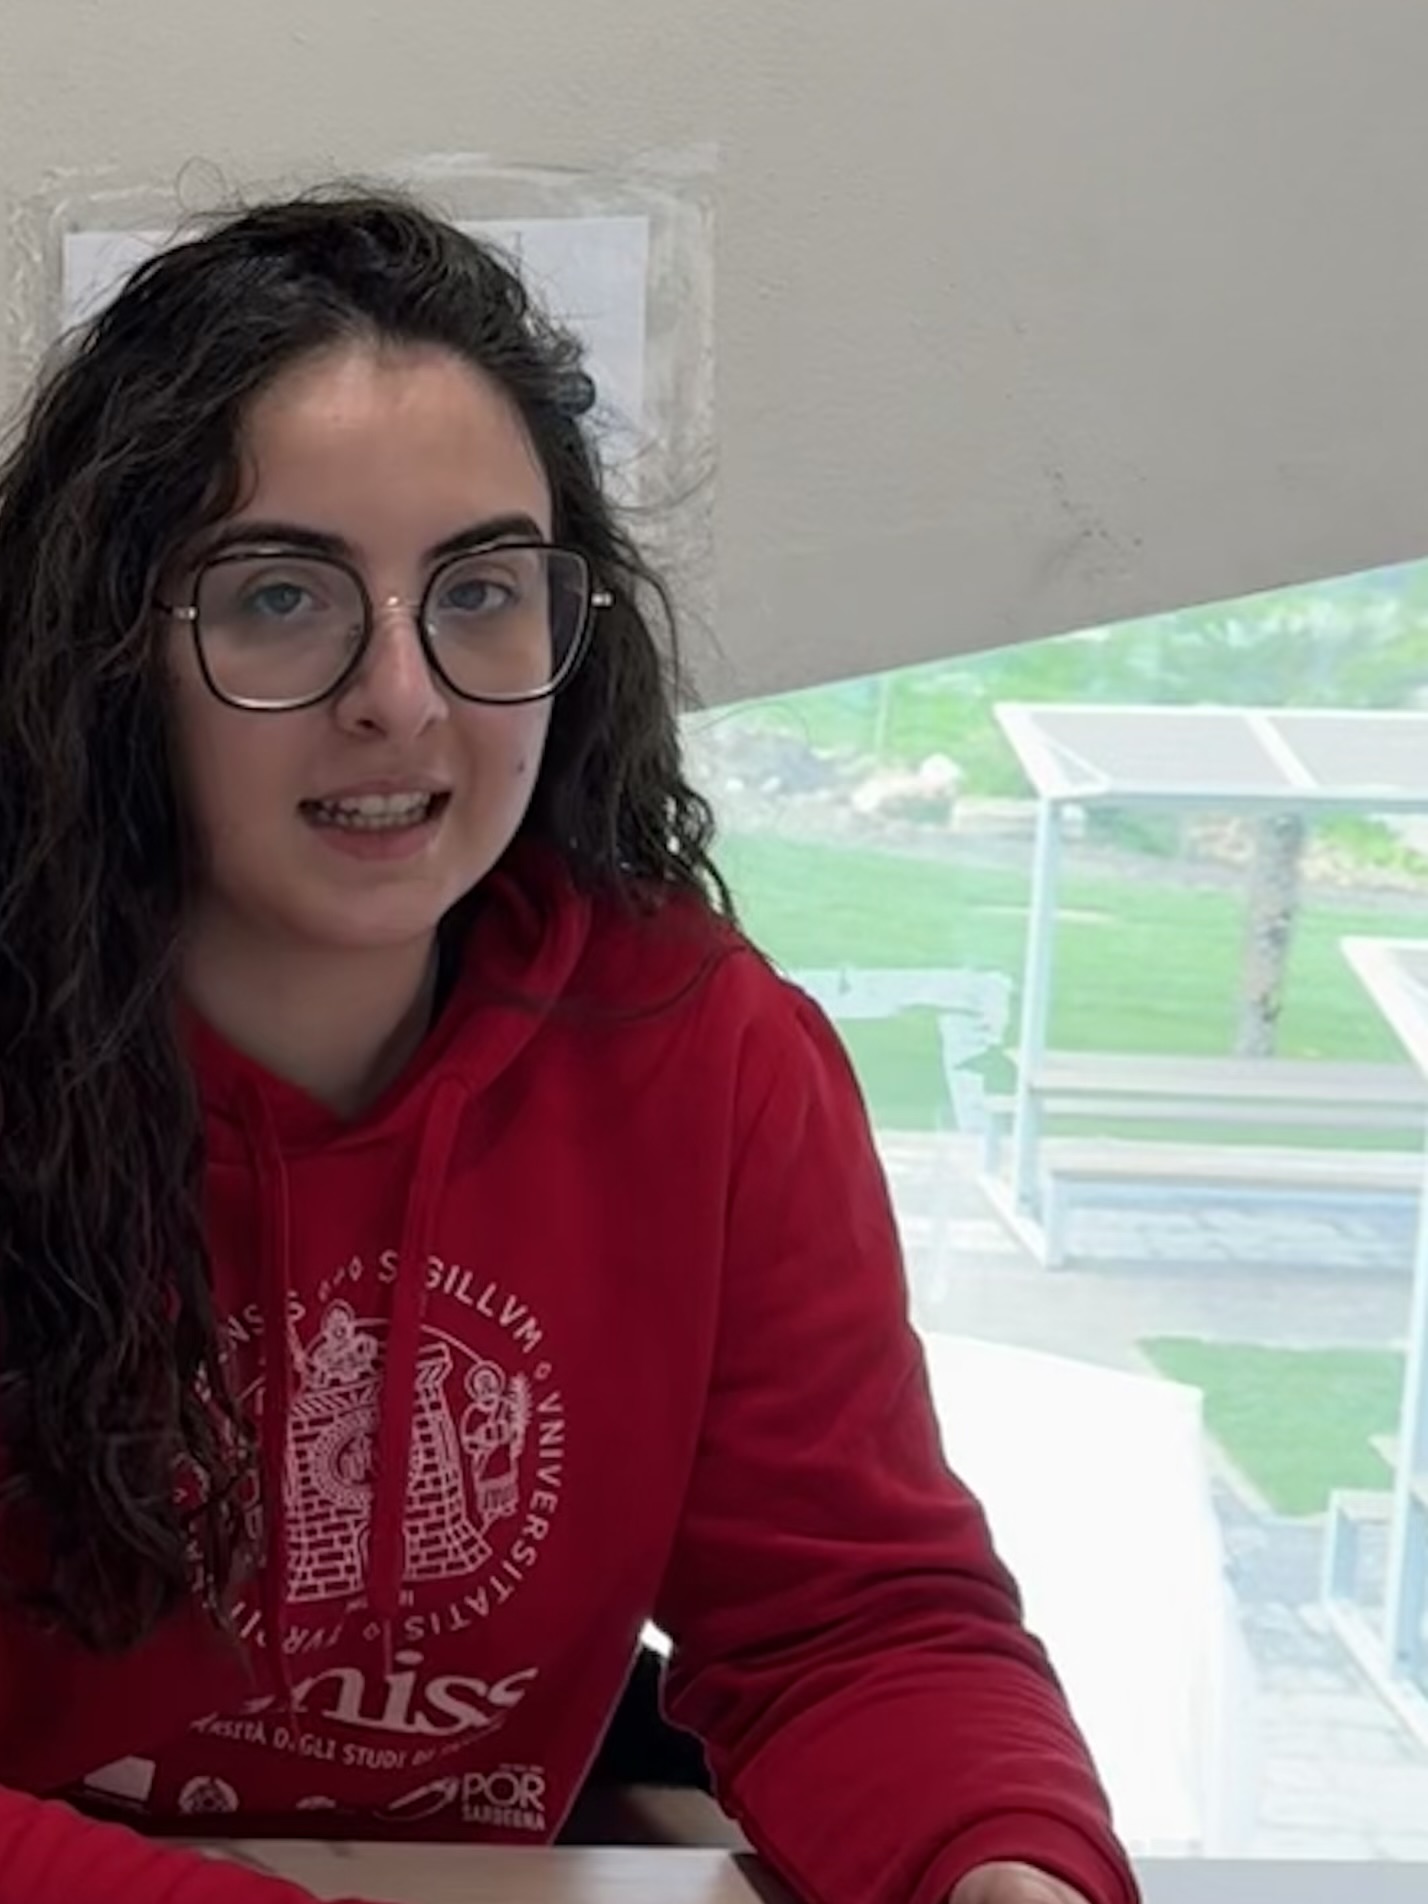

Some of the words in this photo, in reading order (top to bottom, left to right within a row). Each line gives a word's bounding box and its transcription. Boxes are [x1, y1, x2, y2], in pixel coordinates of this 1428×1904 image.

[377, 1249, 544, 1354] SGILLVM
[342, 1742, 409, 1770] STUDI
[462, 1771, 546, 1813] POR
